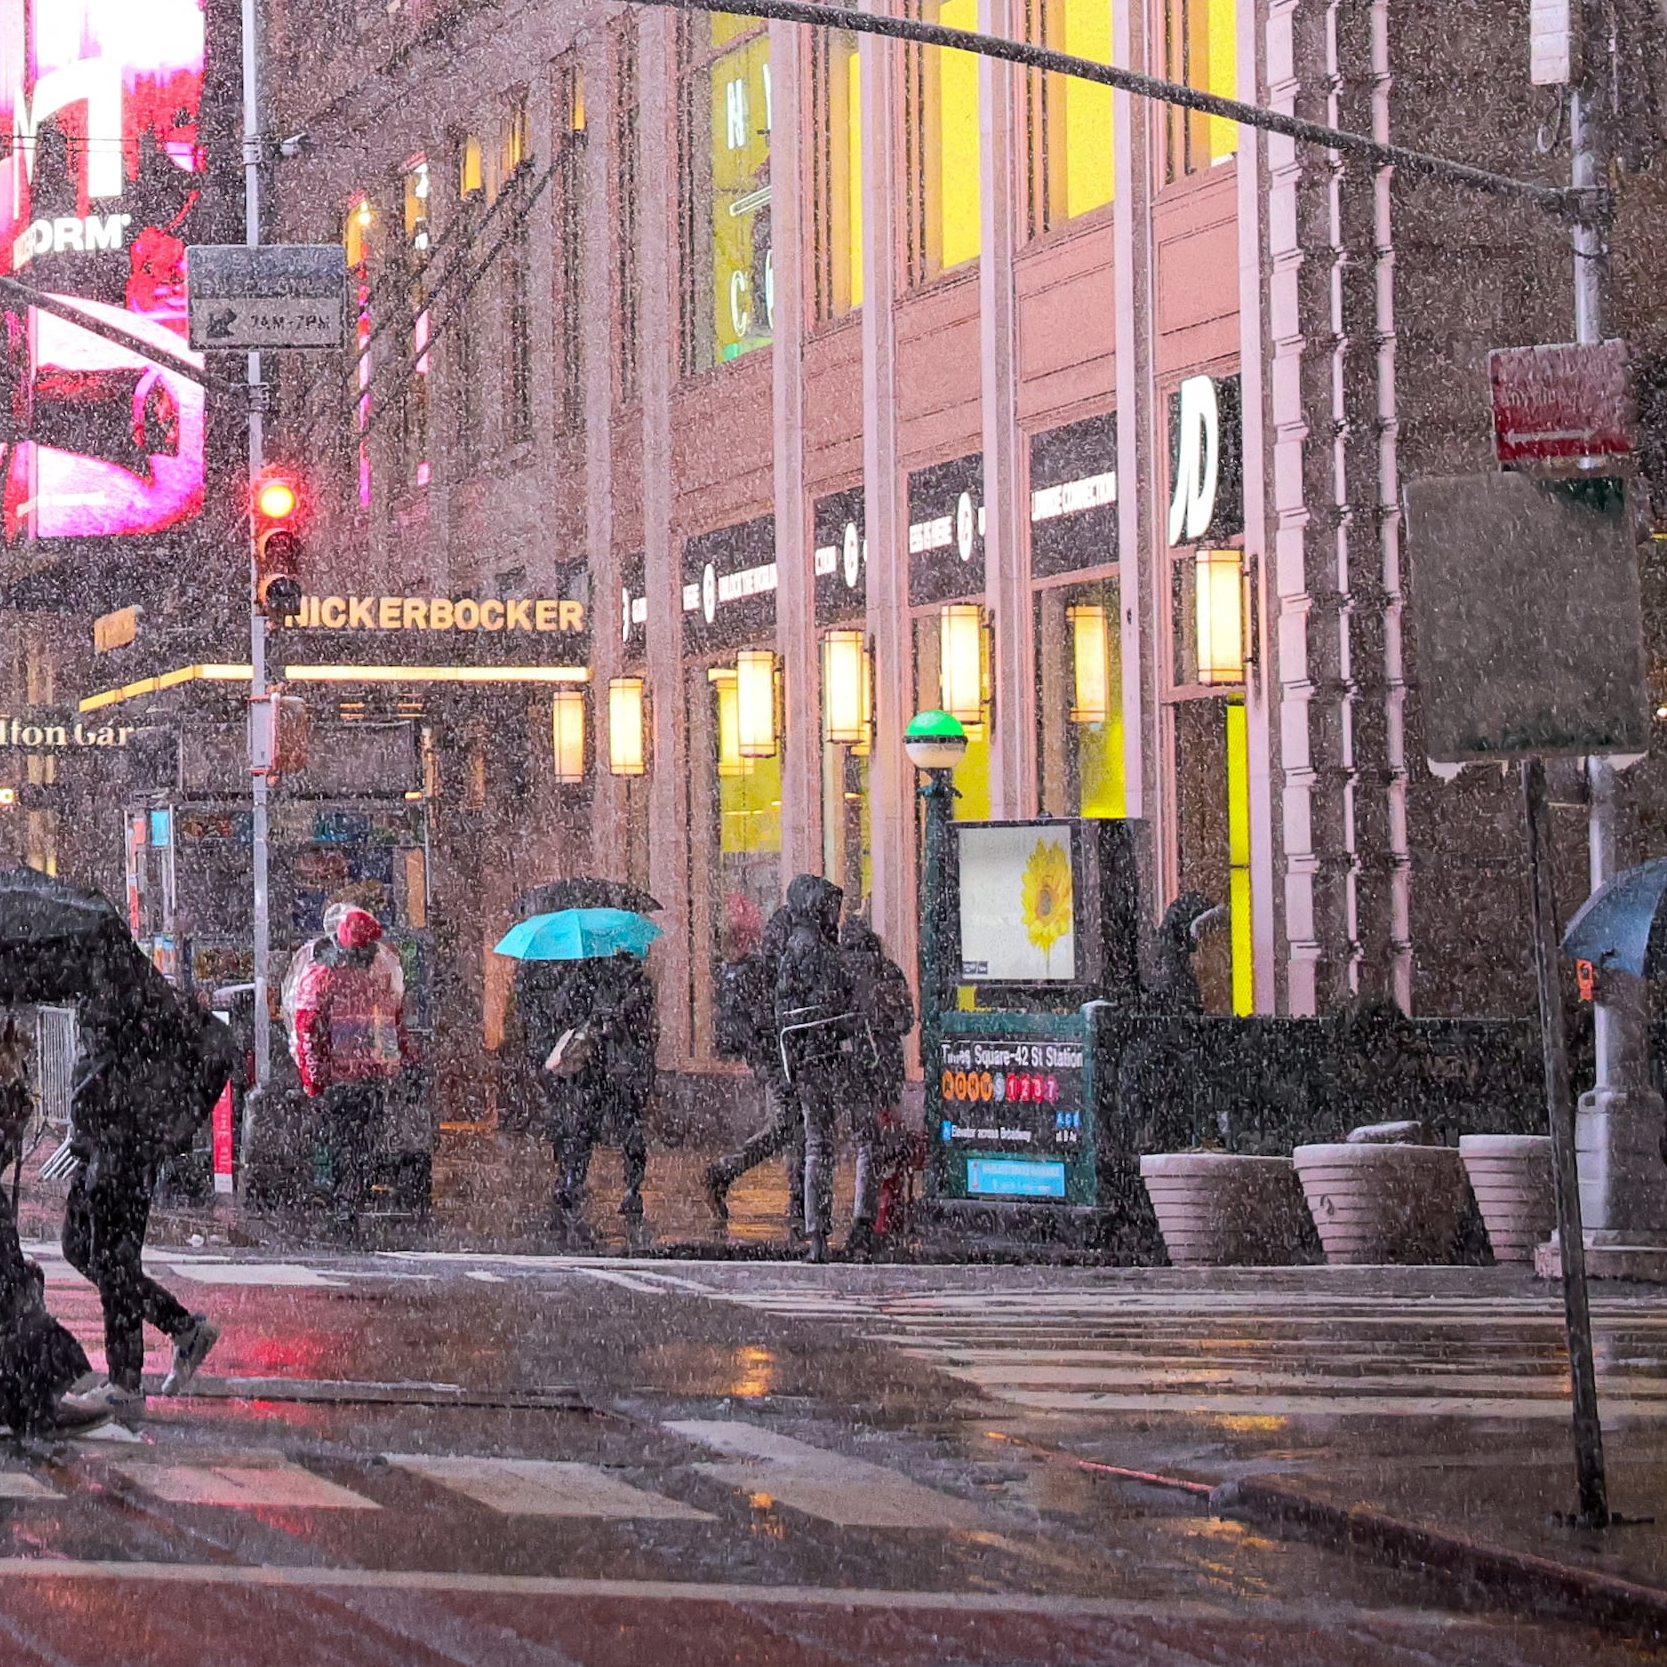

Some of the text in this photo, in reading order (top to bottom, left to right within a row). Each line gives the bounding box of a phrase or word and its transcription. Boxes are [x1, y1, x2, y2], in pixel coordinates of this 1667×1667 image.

[283, 596, 585, 631] NICKERBOCKER
[1031, 1045, 1044, 1067] St
[1046, 1046, 1084, 1068] Station
